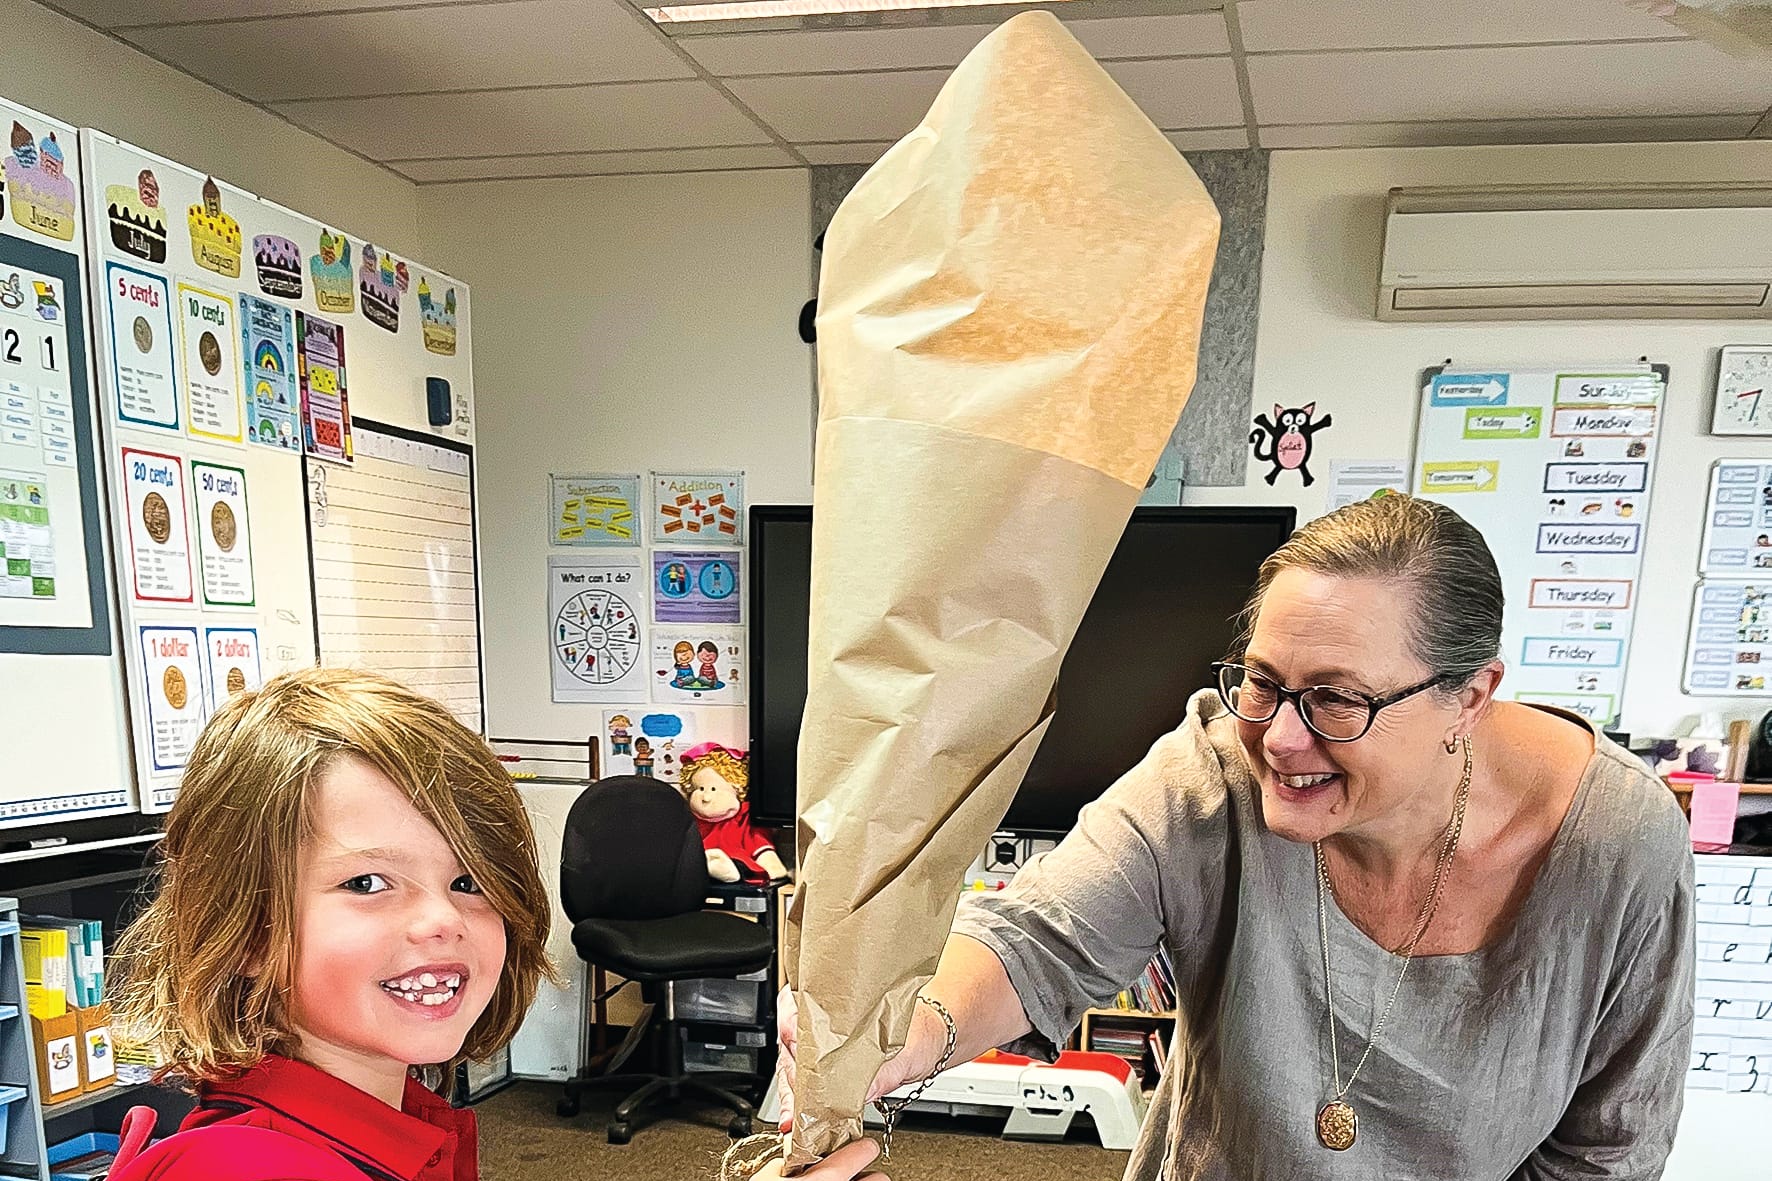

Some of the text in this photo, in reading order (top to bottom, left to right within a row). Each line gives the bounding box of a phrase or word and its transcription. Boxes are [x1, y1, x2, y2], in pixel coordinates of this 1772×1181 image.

[30, 205, 60, 232] June
[127, 230, 151, 260] July
[201, 243, 234, 273] August
[118, 277, 159, 308] 5 cents
[188, 297, 225, 326] 10 cents
[5, 328, 55, 369] 2 1
[134, 461, 174, 488] 20 cents
[203, 472, 214, 492] 50
[1565, 470, 1628, 488] Tuesday
[668, 480, 724, 493] Addition
[1546, 531, 1632, 549] Wednesday
[560, 572, 632, 584] What can I do?
[1546, 587, 1617, 605] Thursday
[151, 638, 158, 658] 1
[216, 639, 223, 657] 2
[1548, 645, 1598, 662] Friday
[1733, 867, 1758, 906] d
[1722, 942, 1739, 963] e
